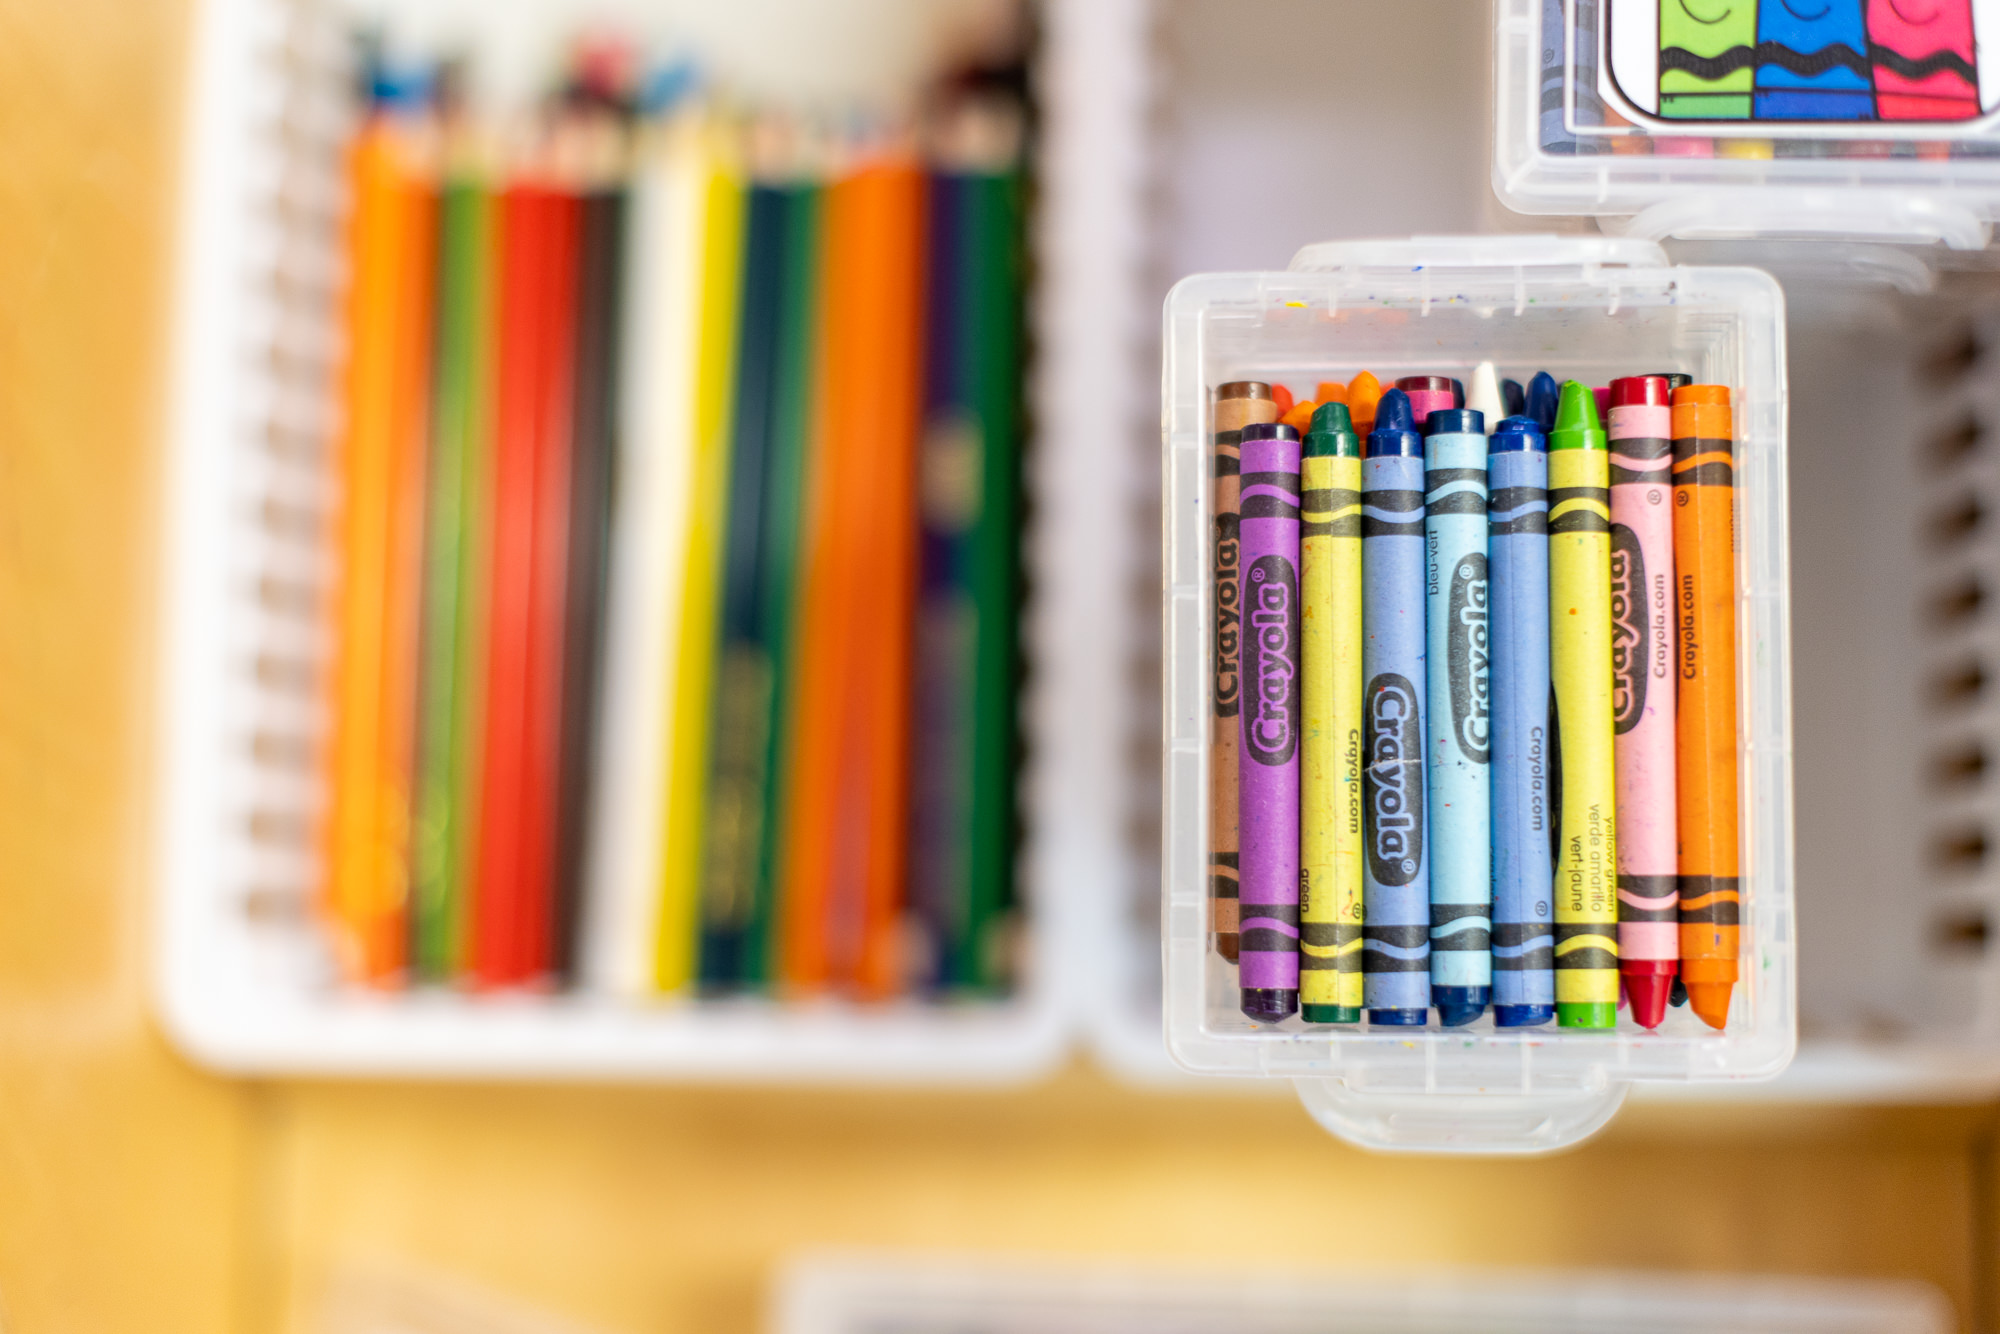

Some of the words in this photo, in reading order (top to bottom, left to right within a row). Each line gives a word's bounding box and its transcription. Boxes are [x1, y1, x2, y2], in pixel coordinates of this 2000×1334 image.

[1216, 540, 1240, 704] Crayola
[1252, 581, 1295, 753] Crayola
[1653, 574, 1668, 679] Crayola.com
[1680, 574, 1698, 680] Crayola.com
[1346, 728, 1360, 834] Crayola.com
[1369, 685, 1415, 860] Crayola
[1527, 726, 1545, 831] Crayola.com
[1589, 803, 1604, 847] verde
[1568, 835, 1585, 912] vert-jaune
[1589, 850, 1605, 912] amarillo
[1603, 816, 1615, 866] yellow
[1604, 869, 1615, 912] green
